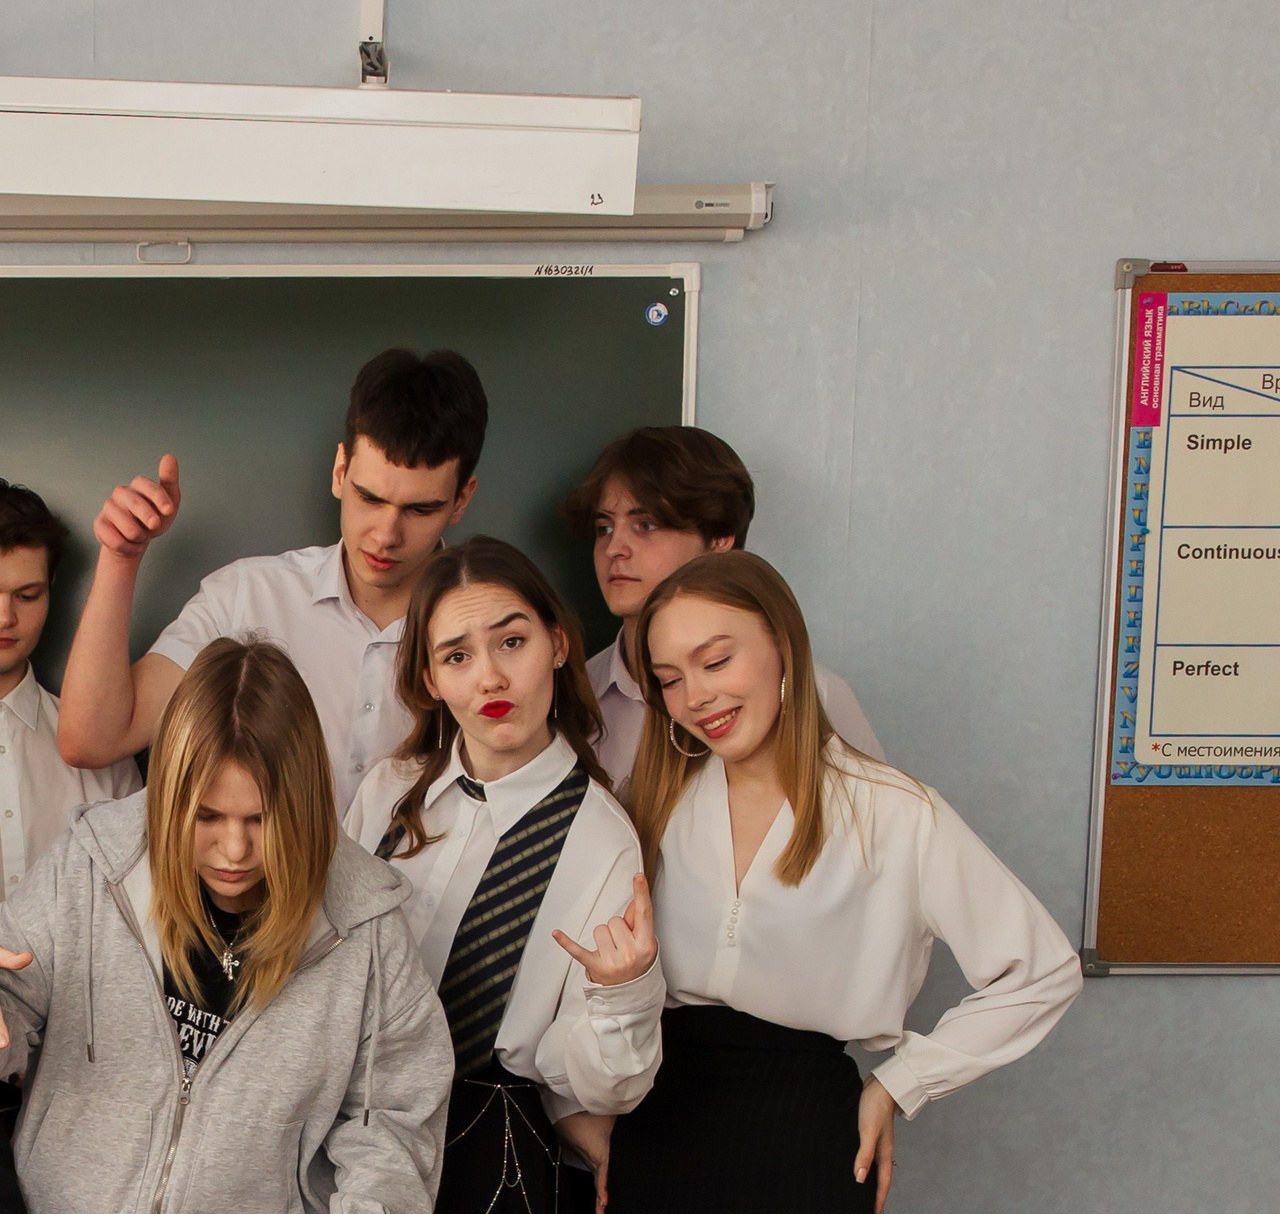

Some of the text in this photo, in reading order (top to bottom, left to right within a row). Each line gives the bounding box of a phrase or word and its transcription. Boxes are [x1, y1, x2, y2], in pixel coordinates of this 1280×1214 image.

[1140, 308, 1154, 406] АНГЛИЙСКИЙ ЯЗЫК
[1152, 305, 1164, 409] основная грамматика
[1189, 392, 1225, 411] Вид
[1186, 433, 1252, 455] Simple
[1177, 543, 1280, 560] Continuou
[1172, 661, 1240, 677] Perfect
[187, 1004, 221, 1033] WITH
